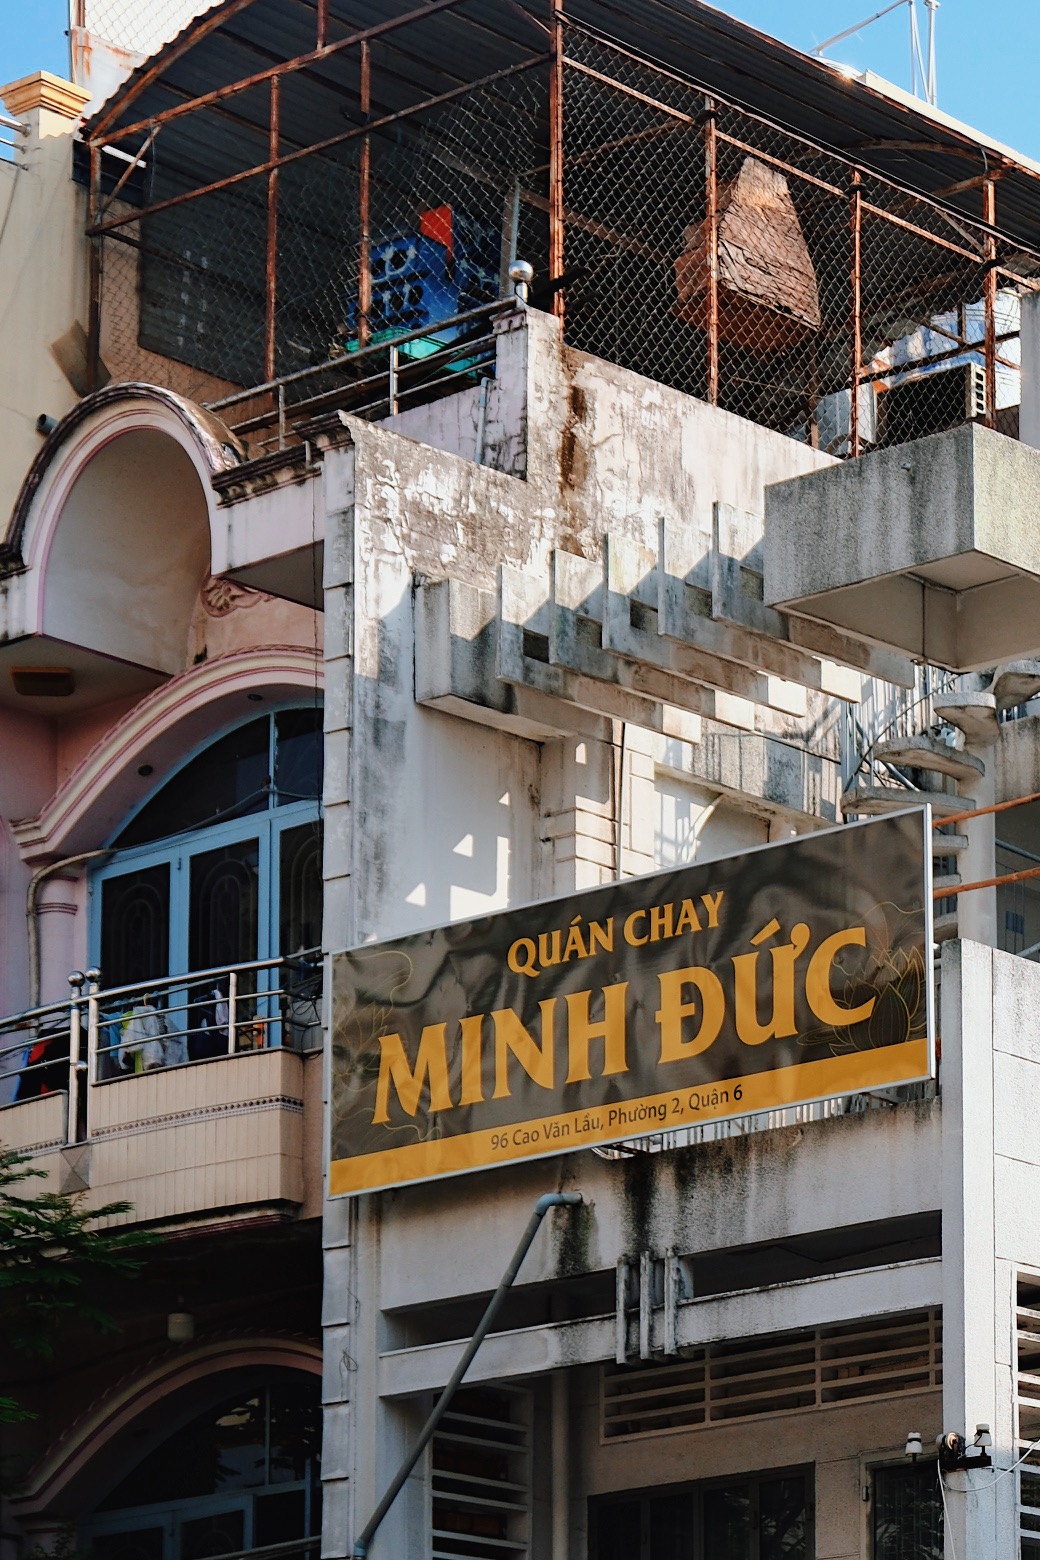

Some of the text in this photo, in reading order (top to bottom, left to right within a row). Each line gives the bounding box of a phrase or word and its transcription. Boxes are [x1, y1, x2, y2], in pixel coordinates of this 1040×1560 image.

[507, 890, 724, 977] QUÁN CHAY
[372, 918, 877, 1125] MINH ĐỨC
[491, 1084, 743, 1150] 96 Cao Văn Lầu, Phường 2, Quận 6
